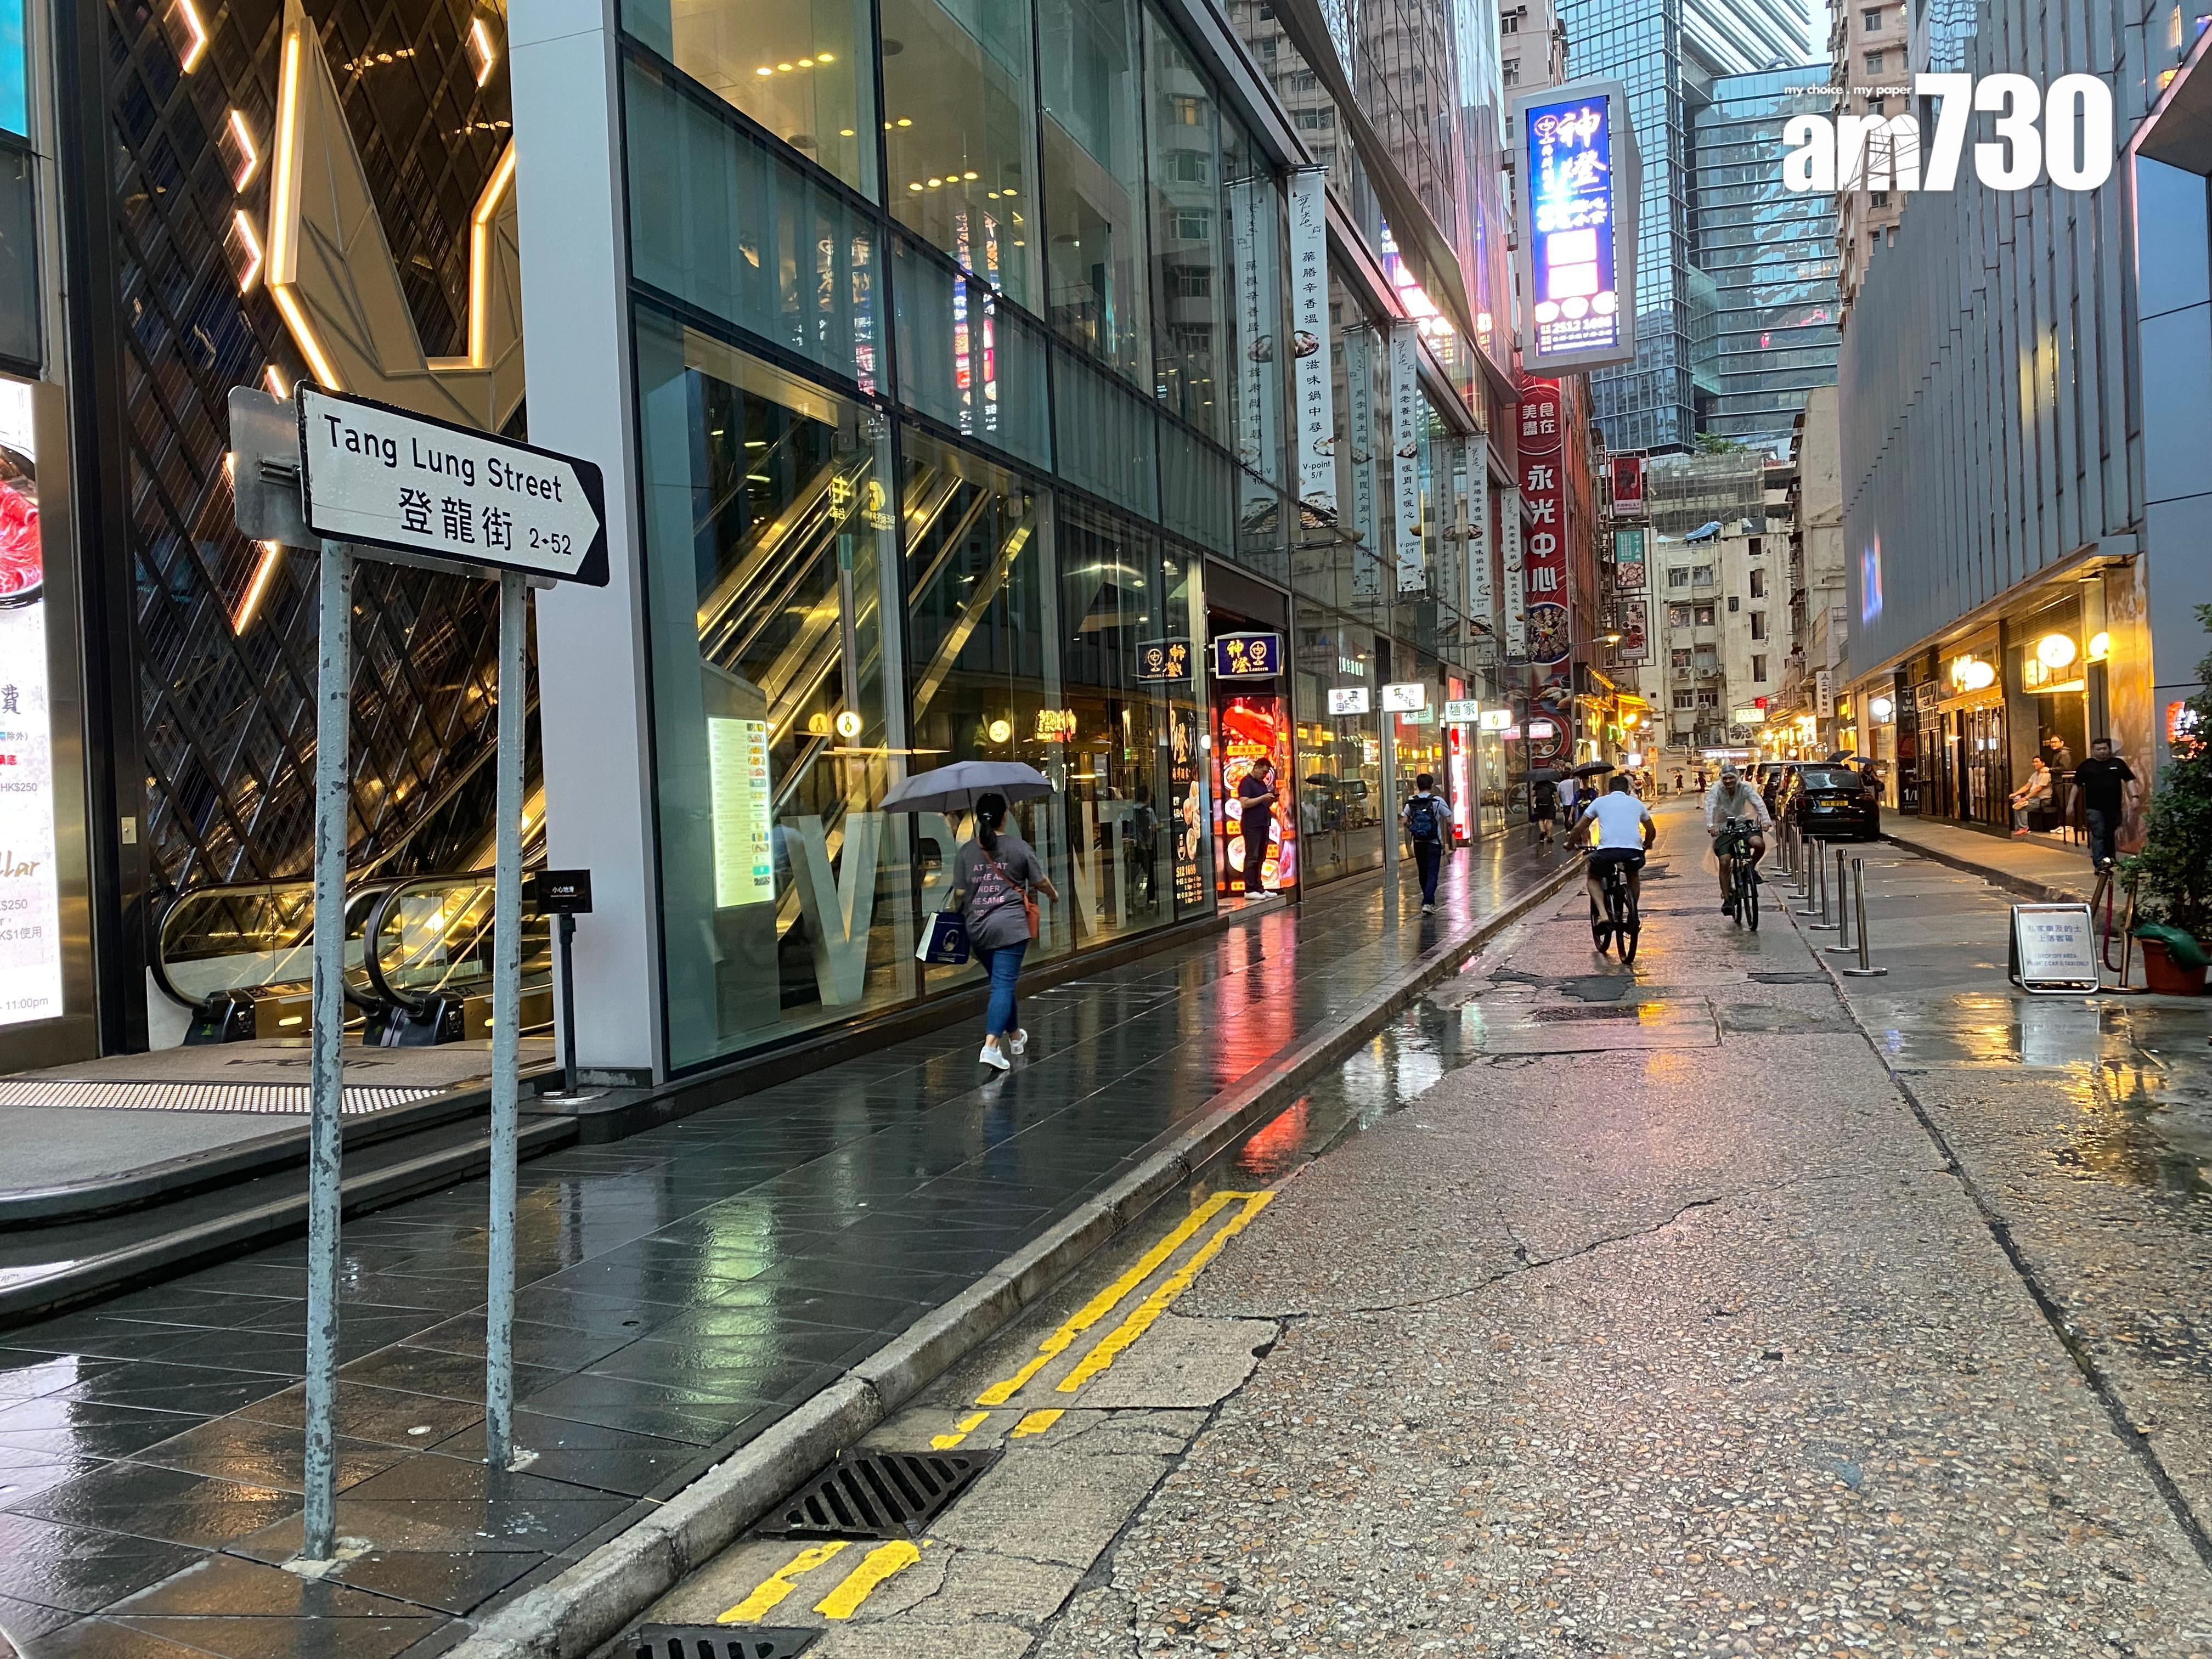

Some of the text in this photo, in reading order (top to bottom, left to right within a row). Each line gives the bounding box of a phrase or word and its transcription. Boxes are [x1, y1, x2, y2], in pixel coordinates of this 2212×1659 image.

[1306, 359, 1323, 432] 滋味鍋中尋
[1522, 402, 1554, 419] 美食
[1523, 419, 1555, 436] 盡在
[324, 414, 562, 503] Tang Lung Street
[1302, 460, 1330, 471] V-point
[399, 487, 512, 551] 登龍街
[1528, 465, 1558, 592] 永光中心
[1399, 540, 1420, 549] V-point
[1227, 639, 1251, 674] 神燈
[1, 684, 21, 714] 費
[1449, 702, 1475, 716] 麵家
[1, 782, 37, 792] HK$250
[978, 885, 1000, 893] NDER
[0, 899, 28, 911] $250
[983, 895, 1005, 905] SAME
[6, 997, 48, 1011] 11:00pm
